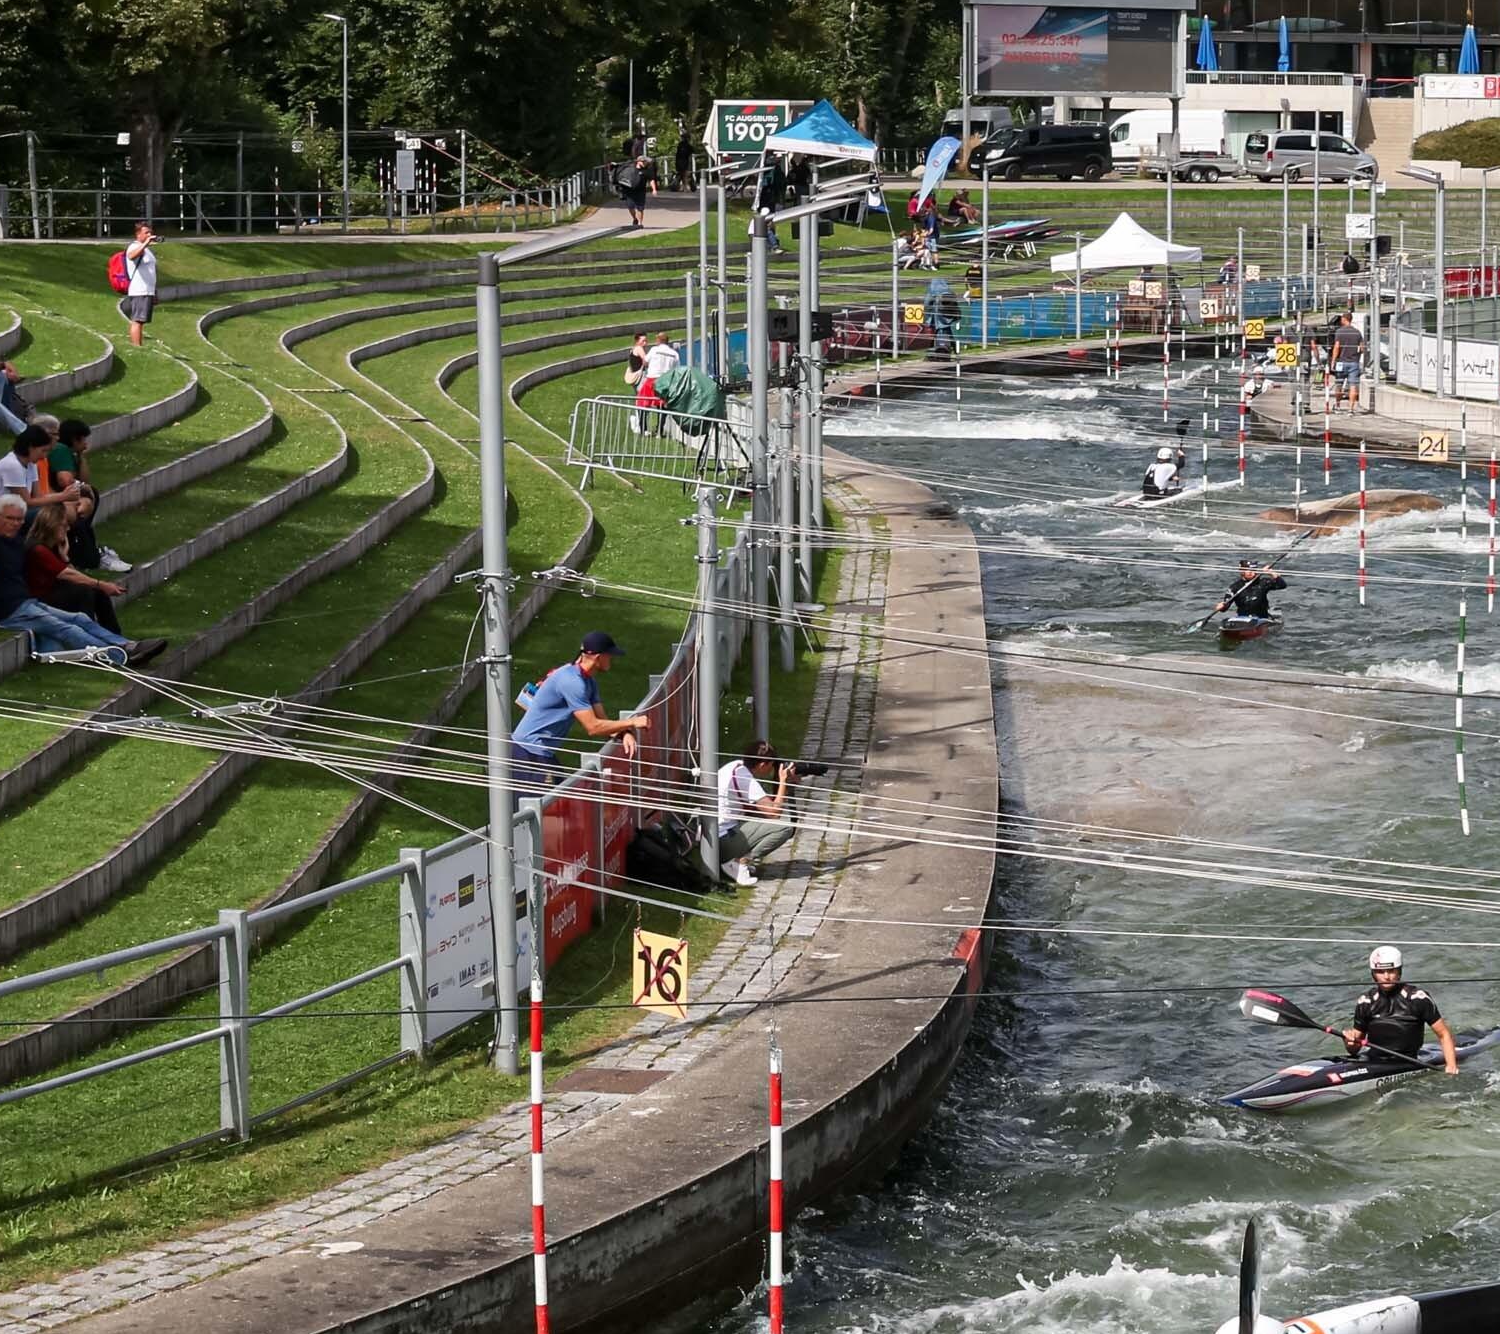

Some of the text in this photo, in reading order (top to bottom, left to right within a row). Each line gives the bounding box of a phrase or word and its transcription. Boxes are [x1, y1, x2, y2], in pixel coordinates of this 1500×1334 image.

[724, 114, 779, 122] FC AUGSBURG
[724, 122, 779, 142] 1907
[905, 307, 923, 321] 30
[1201, 302, 1216, 315] 31
[1246, 323, 1263, 336] 29
[1276, 347, 1296, 363] 28
[1419, 436, 1446, 457] 24
[551, 900, 577, 939] Augsburg
[459, 964, 476, 983] IMAS
[638, 946, 682, 1003] 16
